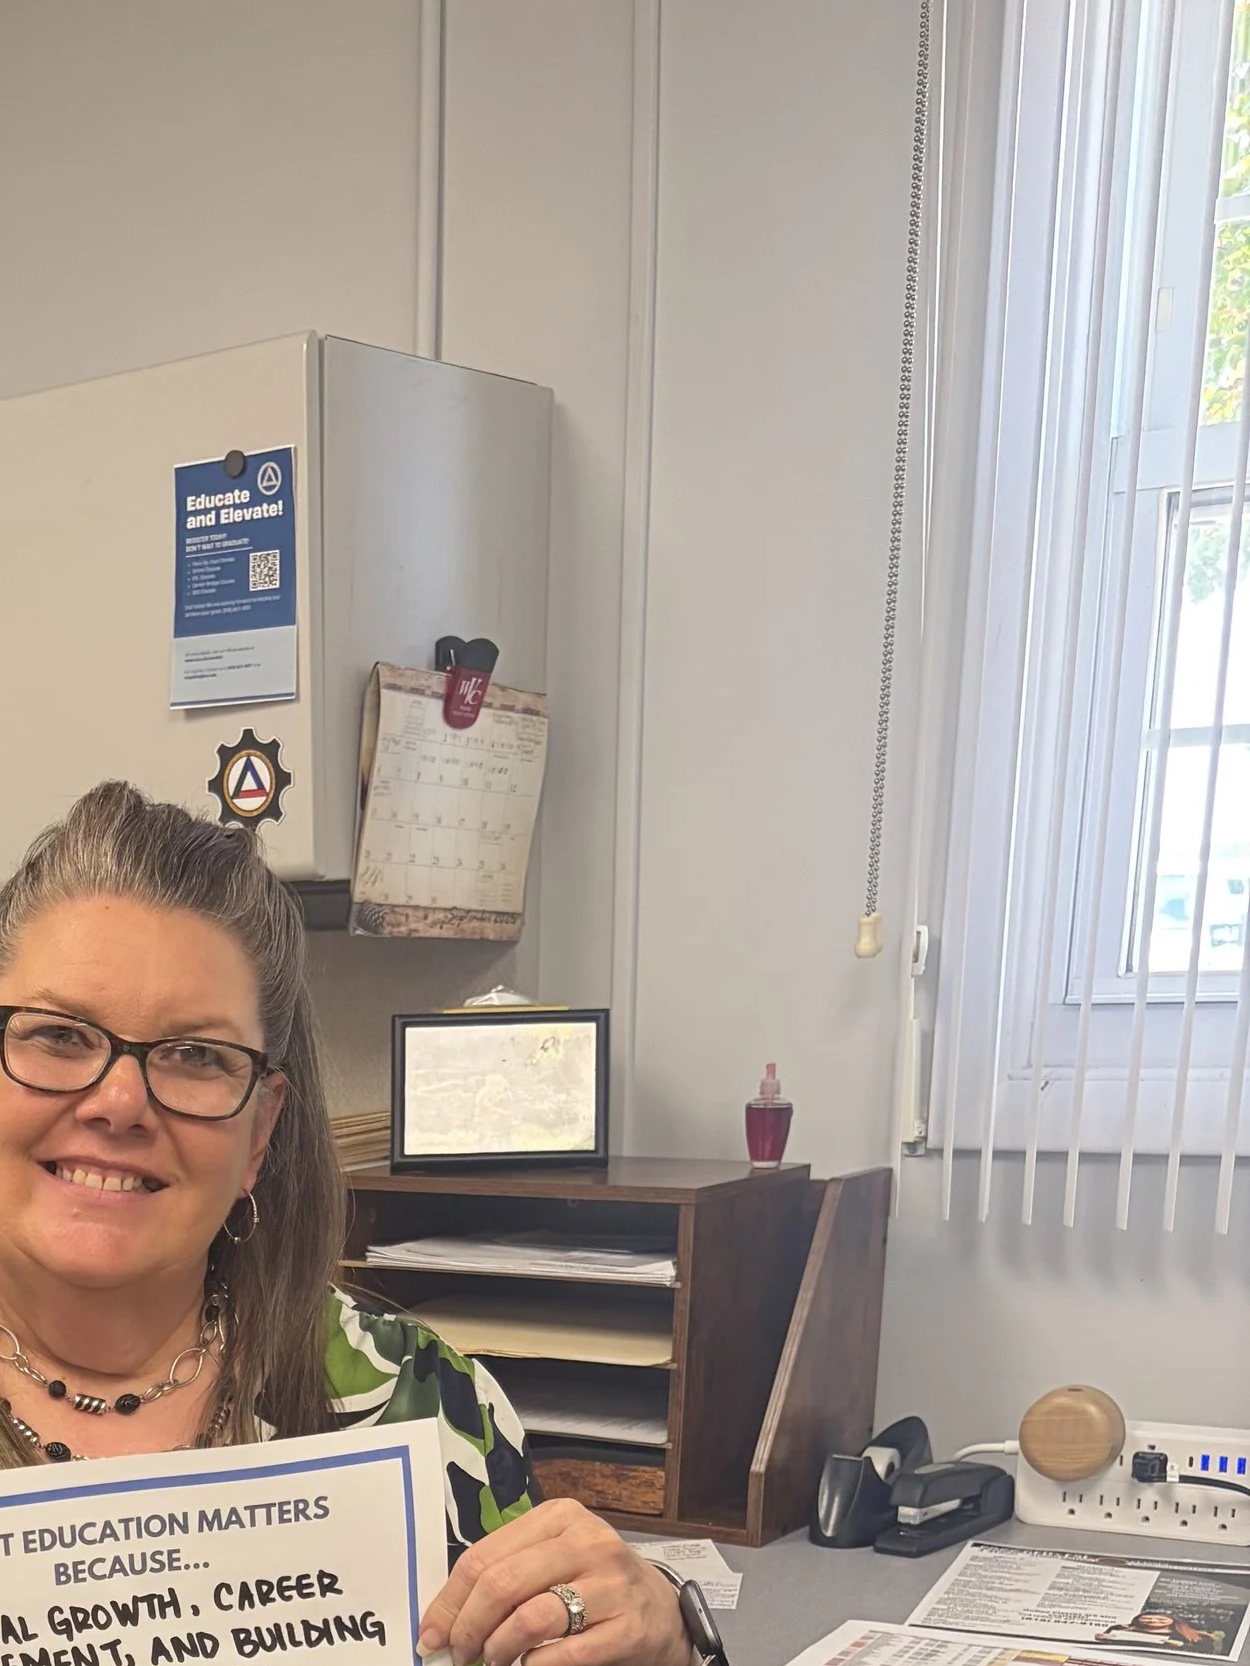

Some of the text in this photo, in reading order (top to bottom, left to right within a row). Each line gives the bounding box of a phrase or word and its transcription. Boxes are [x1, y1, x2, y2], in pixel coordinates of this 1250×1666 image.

[187, 489, 250, 511] Educate
[187, 500, 283, 529] and Elevate!
[22, 1513, 190, 1554] EDUCATION
[197, 1496, 331, 1535] MATTERS
[53, 1549, 210, 1588] BECAUSE...
[213, 1569, 343, 1612] CAREER
[149, 1630, 220, 1664] AND
[231, 1612, 387, 1658] BUILDING
